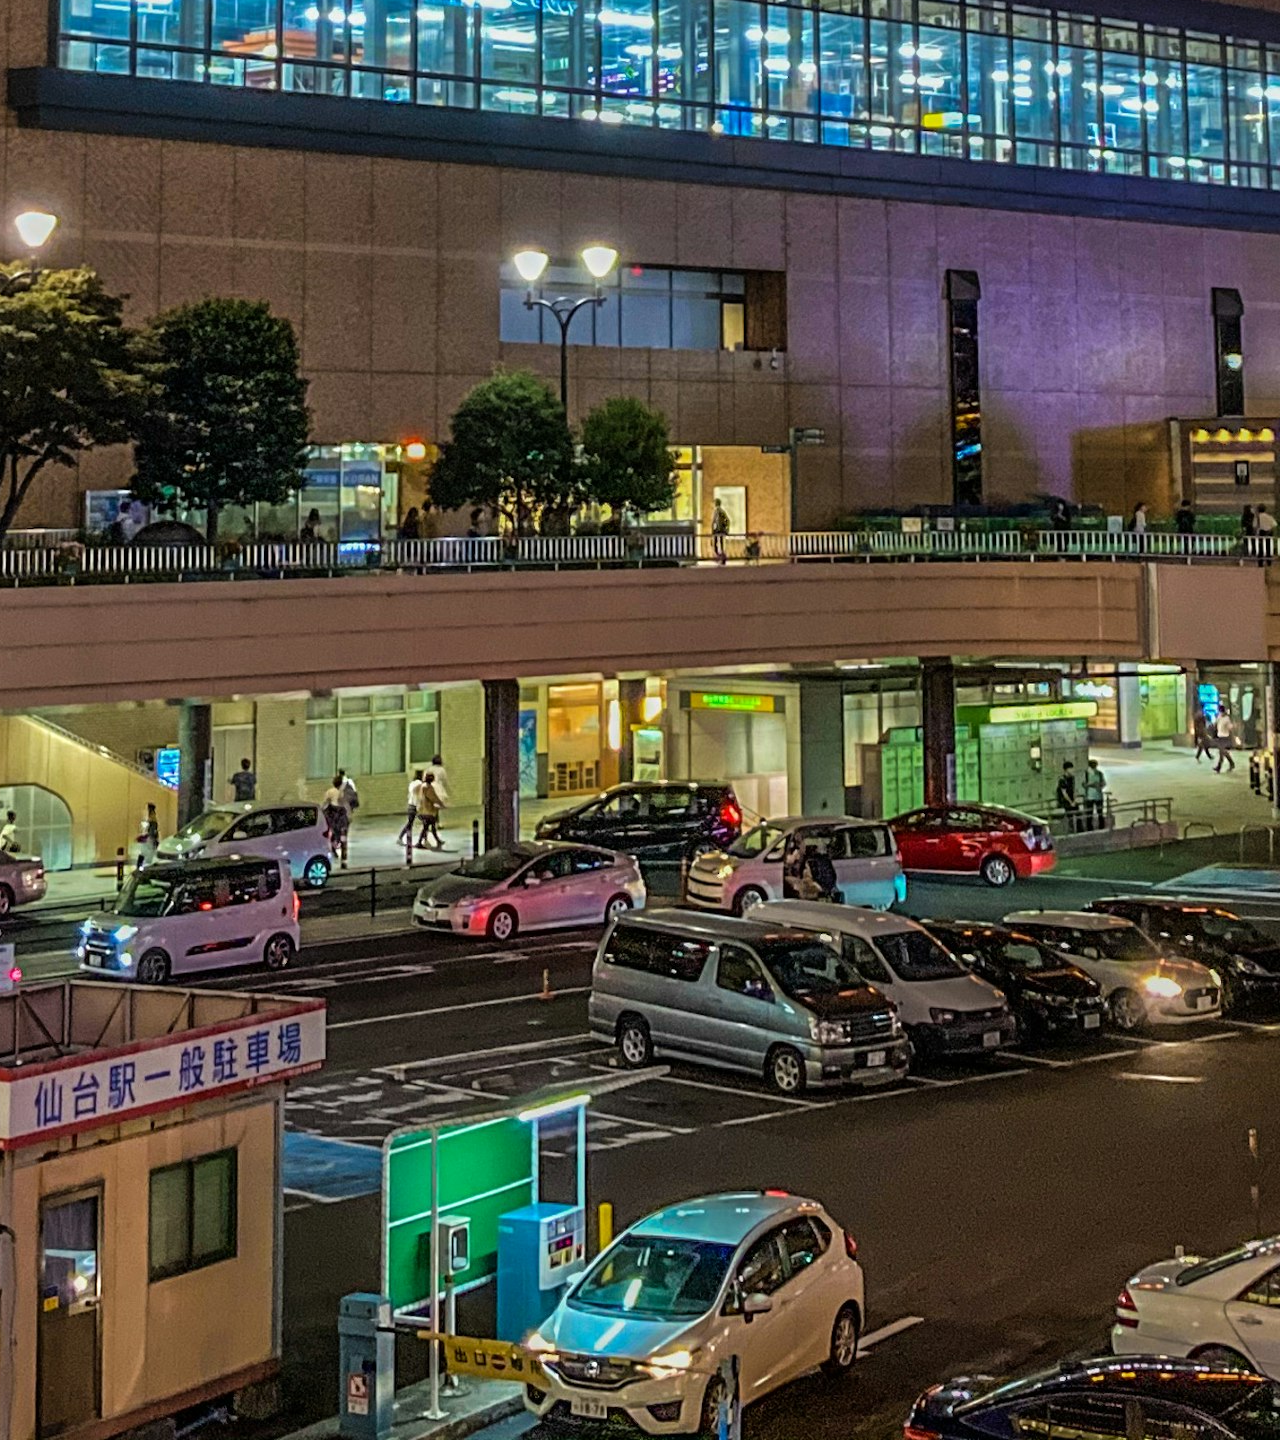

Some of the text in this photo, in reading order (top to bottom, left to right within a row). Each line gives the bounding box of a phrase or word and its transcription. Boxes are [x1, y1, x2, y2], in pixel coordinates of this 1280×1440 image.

[34, 1022, 303, 1128] 仙台駅一般駐車場
[454, 1345, 487, 1366] 出口
